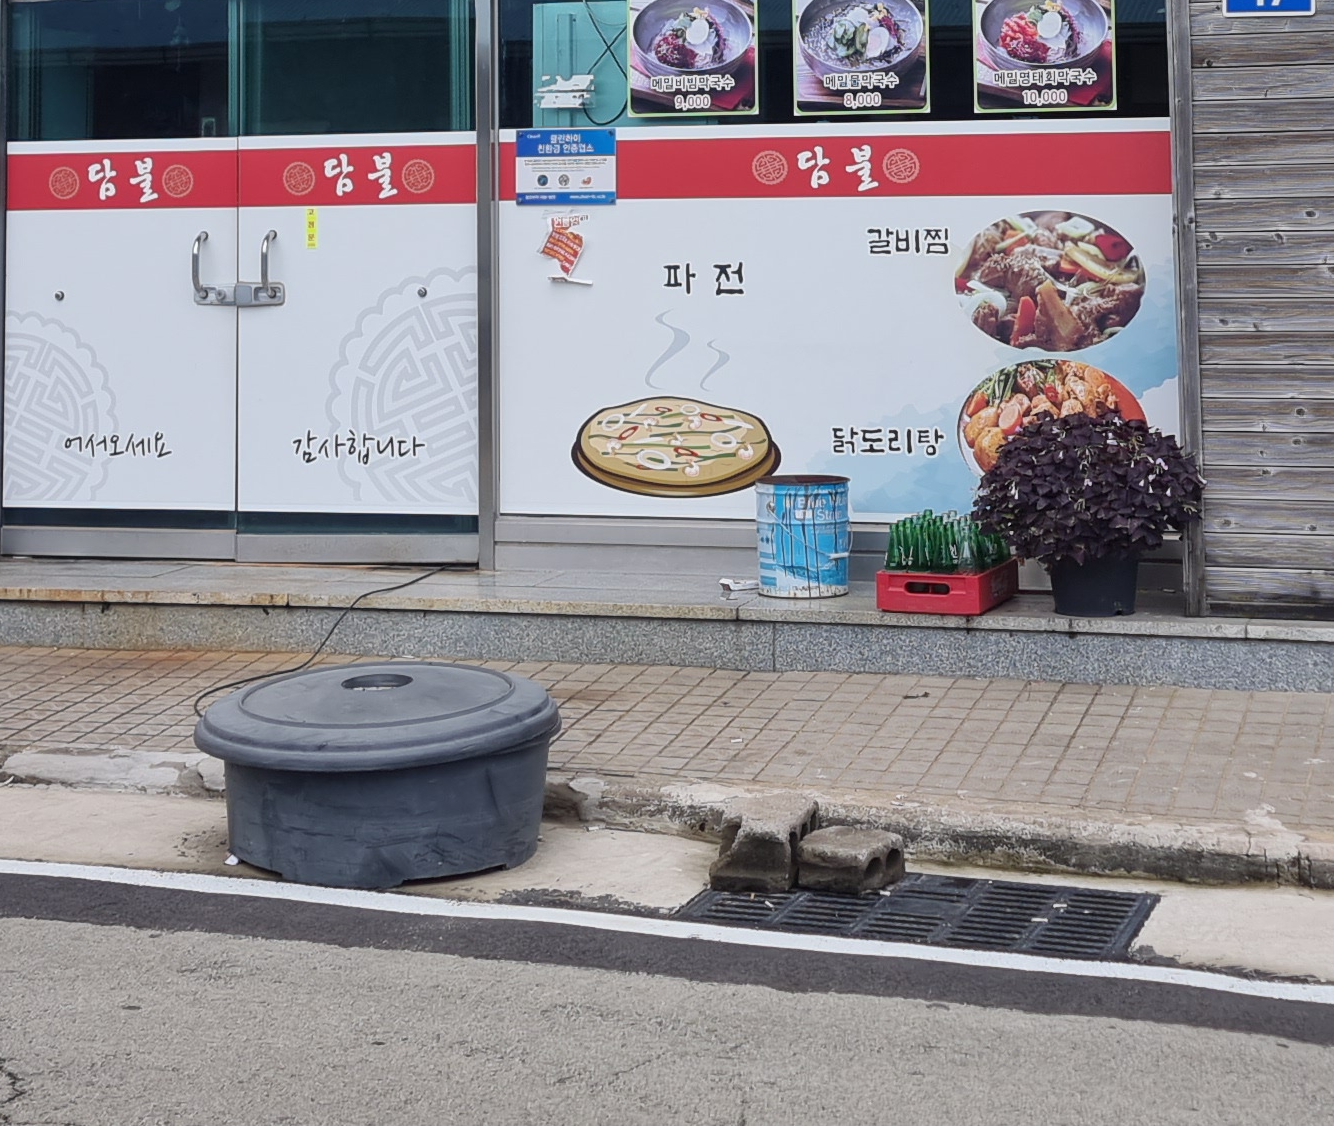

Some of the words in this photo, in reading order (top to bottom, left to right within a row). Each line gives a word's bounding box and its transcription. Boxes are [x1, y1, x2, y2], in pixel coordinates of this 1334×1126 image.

[651, 74, 735, 92] 메밀비빔막국수
[824, 72, 899, 90] 메밀물막국수
[674, 94, 711, 111] 9,000
[844, 91, 881, 109] 8,000
[1022, 89, 1068, 106] 10,000
[88, 156, 159, 203] 담불
[323, 152, 398, 199] 담불
[797, 144, 880, 192] 담불
[867, 226, 950, 257] 갈비찜
[64, 431, 173, 460] 어서오세요
[292, 429, 425, 464] 감사합니다
[831, 427, 944, 456] 닭도리탕
